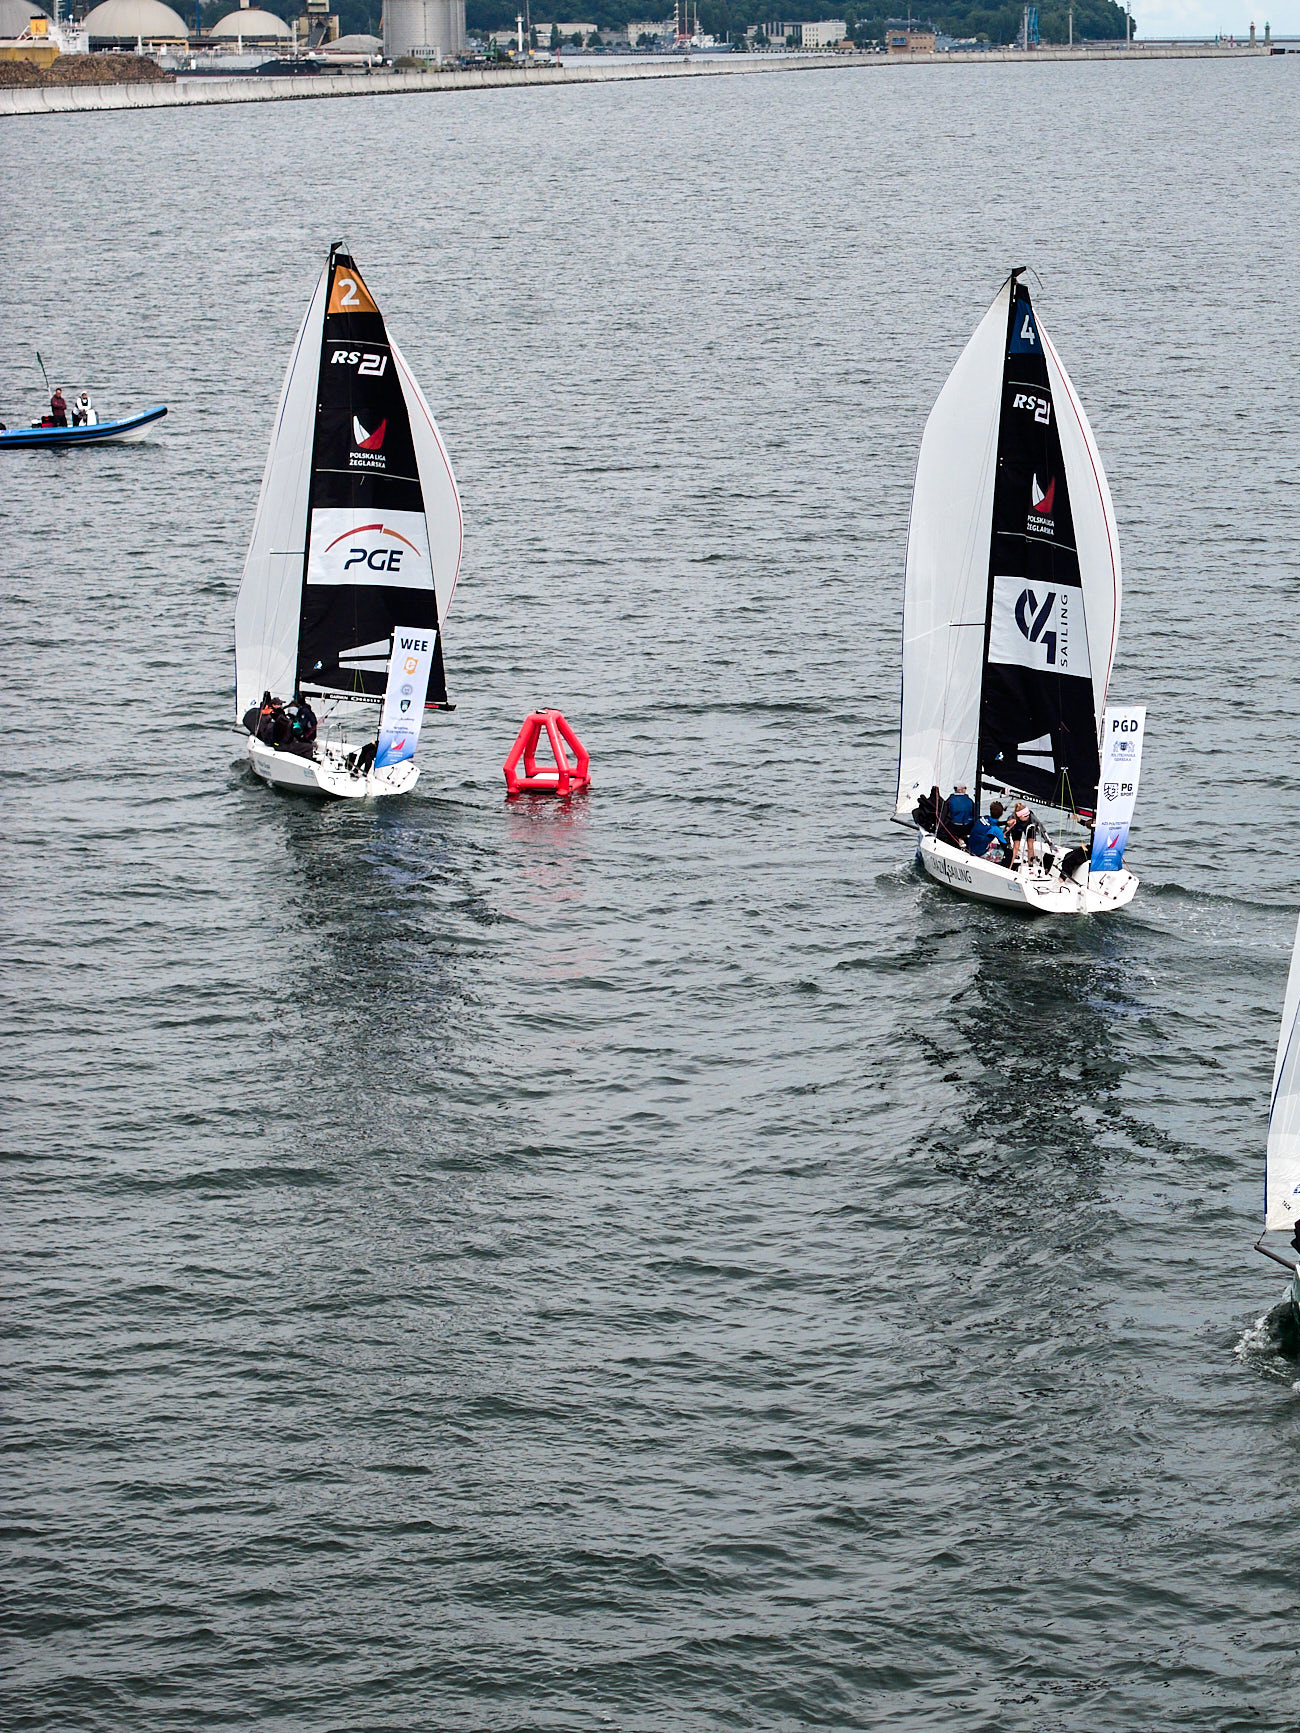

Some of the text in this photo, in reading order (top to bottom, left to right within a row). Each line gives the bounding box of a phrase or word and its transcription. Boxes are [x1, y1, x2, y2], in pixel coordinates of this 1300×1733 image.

[338, 278, 360, 306] 2
[1020, 314, 1035, 345] 4
[330, 350, 388, 377] RS21
[1012, 393, 1050, 425] RS21
[349, 458, 386, 469] ŻEGLARSKA
[350, 452, 374, 462] POLSKA
[344, 549, 403, 572] PGE
[400, 637, 428, 652] WEE
[1112, 719, 1138, 732] PGD
[1121, 783, 1133, 792] PG
